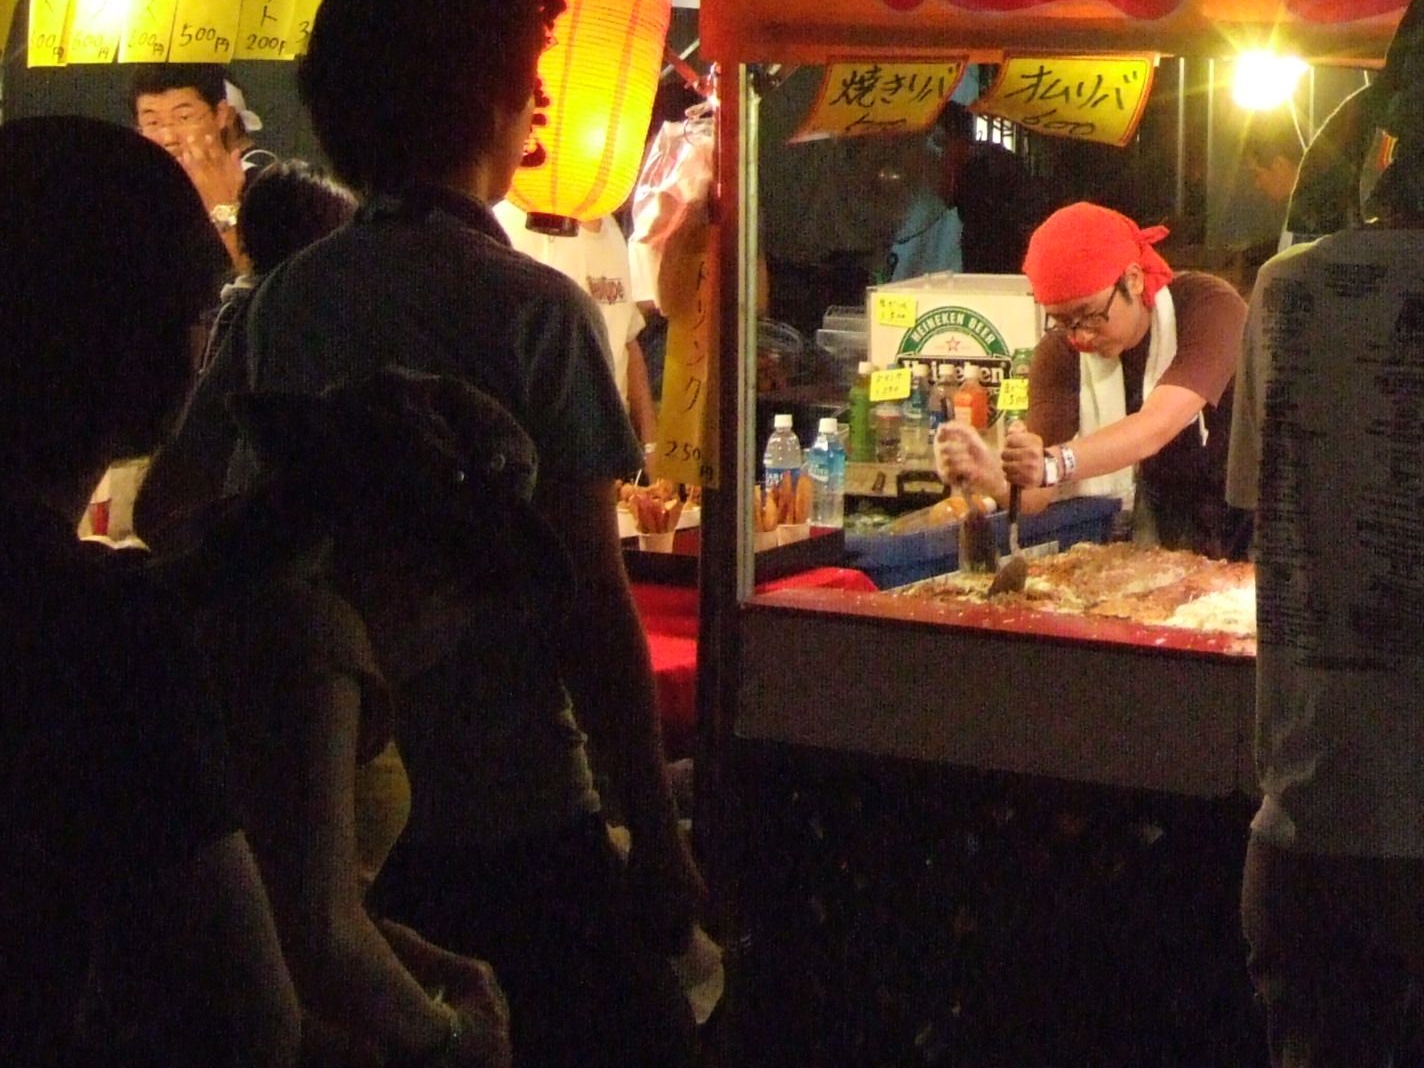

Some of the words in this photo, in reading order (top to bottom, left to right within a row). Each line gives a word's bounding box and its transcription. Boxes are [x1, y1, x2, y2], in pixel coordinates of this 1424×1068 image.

[180, 24, 230, 53] 500円
[911, 312, 966, 343] HEINEKEN
[968, 318, 997, 345] BEER
